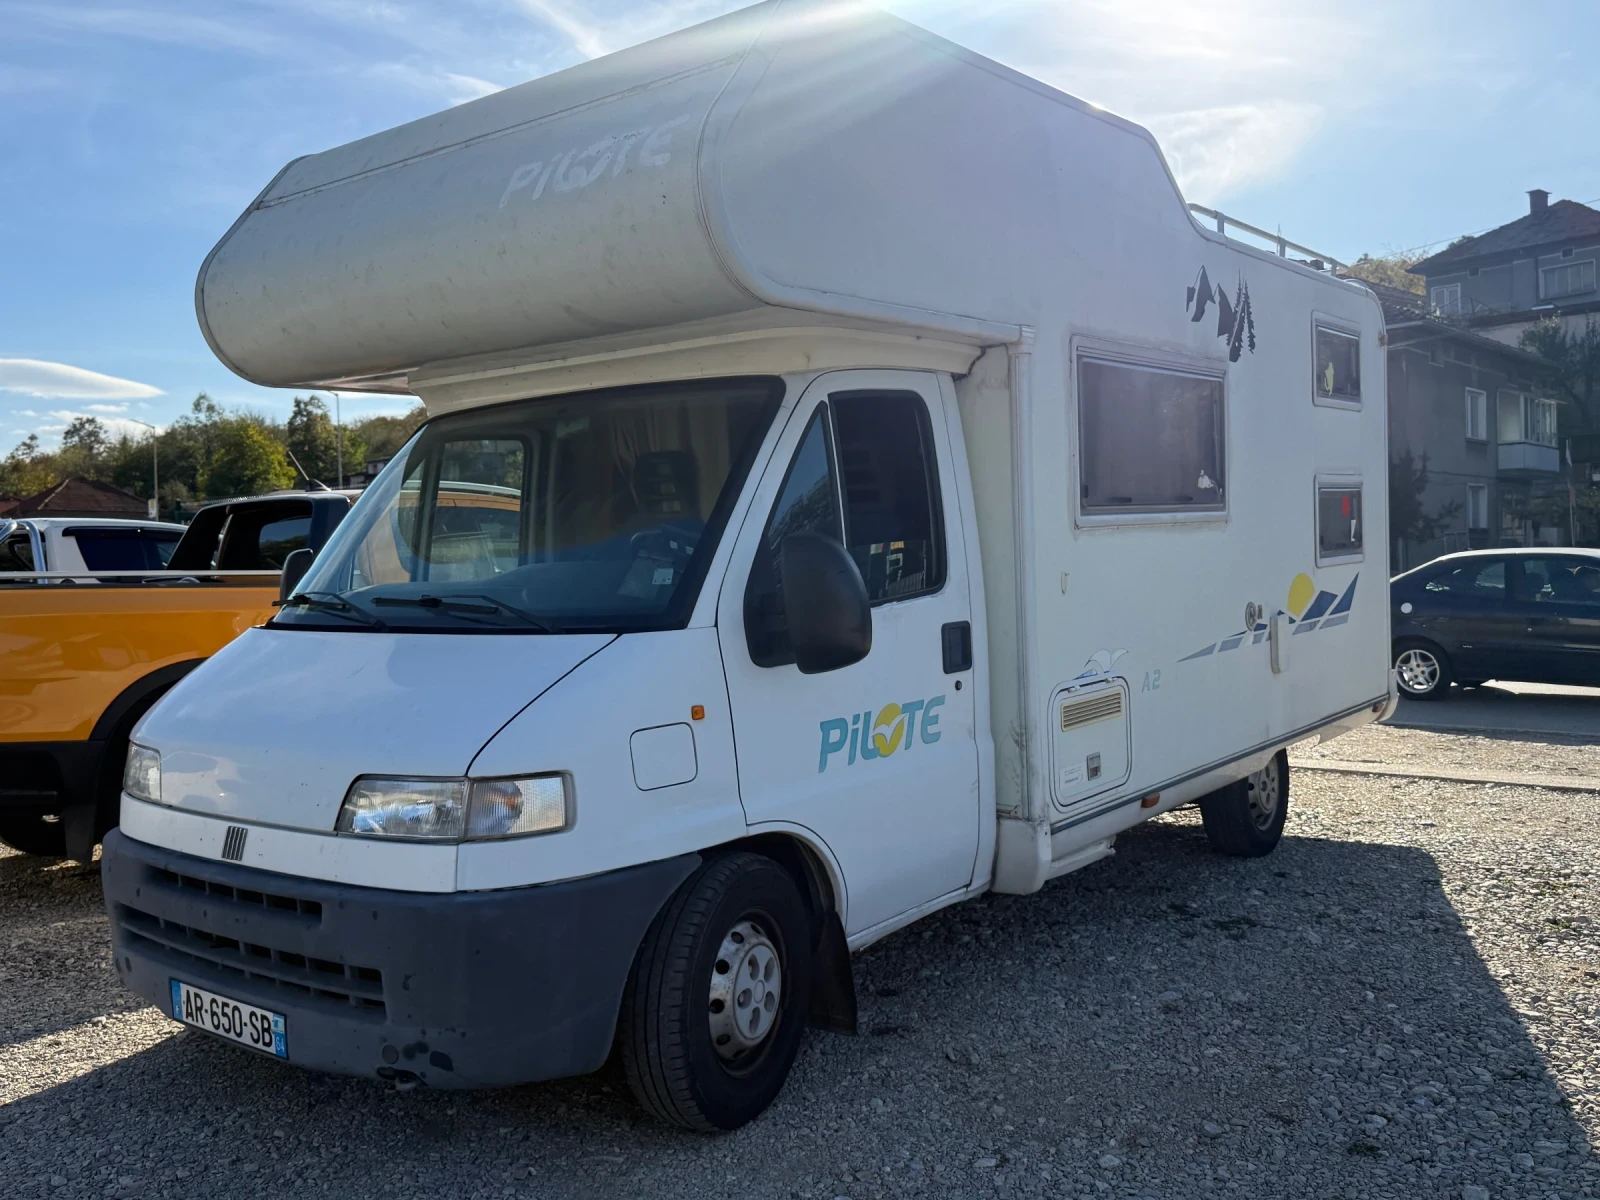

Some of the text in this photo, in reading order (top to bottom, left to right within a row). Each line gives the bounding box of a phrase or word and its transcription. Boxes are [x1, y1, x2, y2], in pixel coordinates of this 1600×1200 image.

[1141, 669, 1162, 693] A2
[185, 989, 273, 1048] AR-650-SB
[275, 1036, 285, 1053] 64
